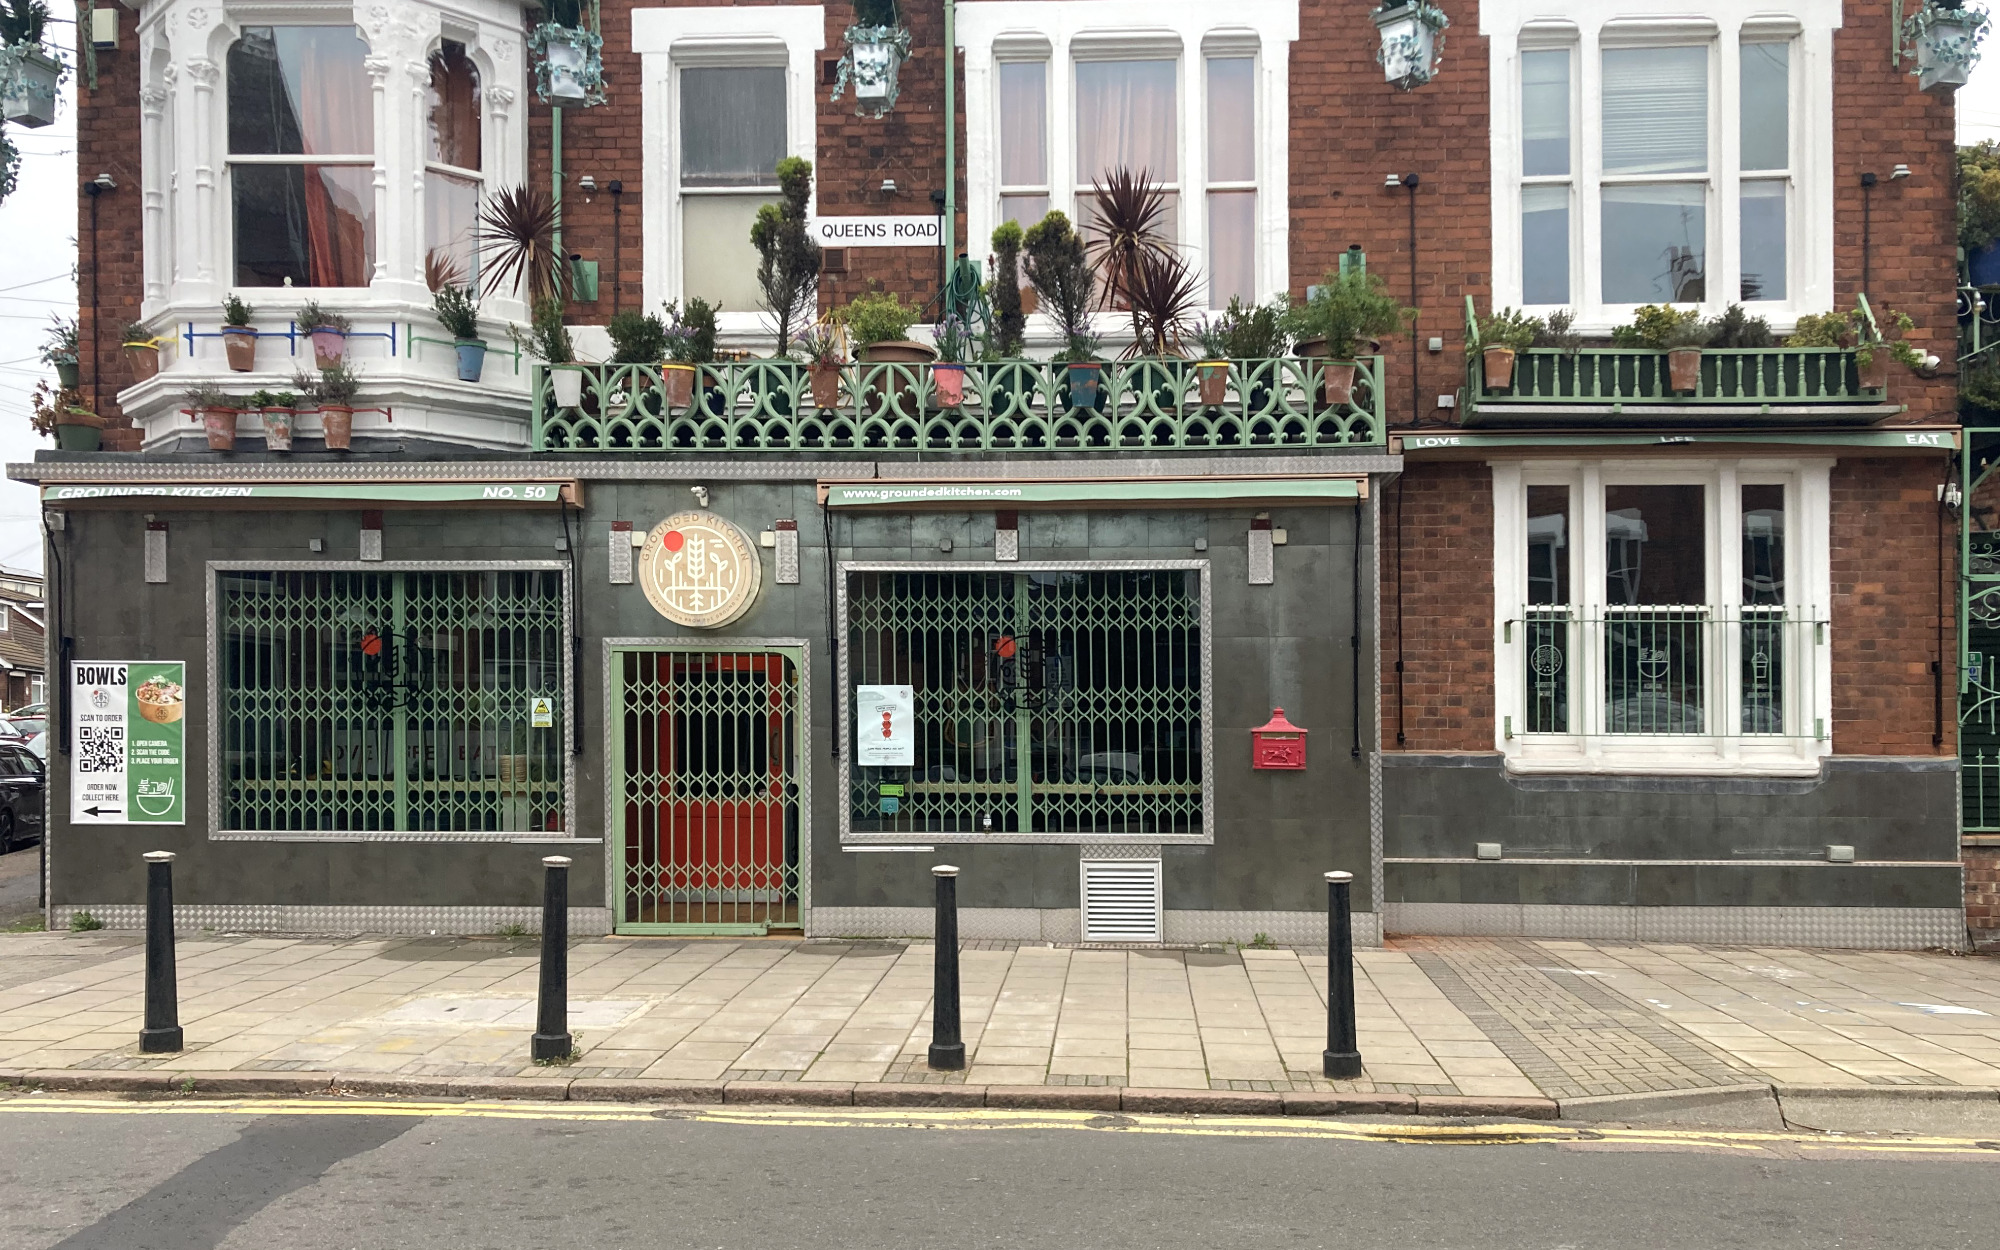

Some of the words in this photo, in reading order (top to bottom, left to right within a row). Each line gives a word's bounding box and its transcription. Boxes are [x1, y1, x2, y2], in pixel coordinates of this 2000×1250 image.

[822, 224, 887, 238] QUEENS
[894, 223, 938, 237] ROAD
[1416, 437, 1461, 448] LOVE
[1905, 434, 1940, 445] EAT
[57, 487, 168, 499] GROUNDED
[170, 487, 254, 497] KITCHEN
[483, 486, 518, 498] NO.
[524, 486, 547, 498] 50
[843, 487, 1022, 499] www.groundedkitchen.com
[642, 513, 700, 561] GROUNDED
[706, 514, 750, 561] KITCHEN
[77, 667, 127, 686] BOWLS
[80, 714, 95, 722] SCAN
[104, 714, 123, 722] ORDER
